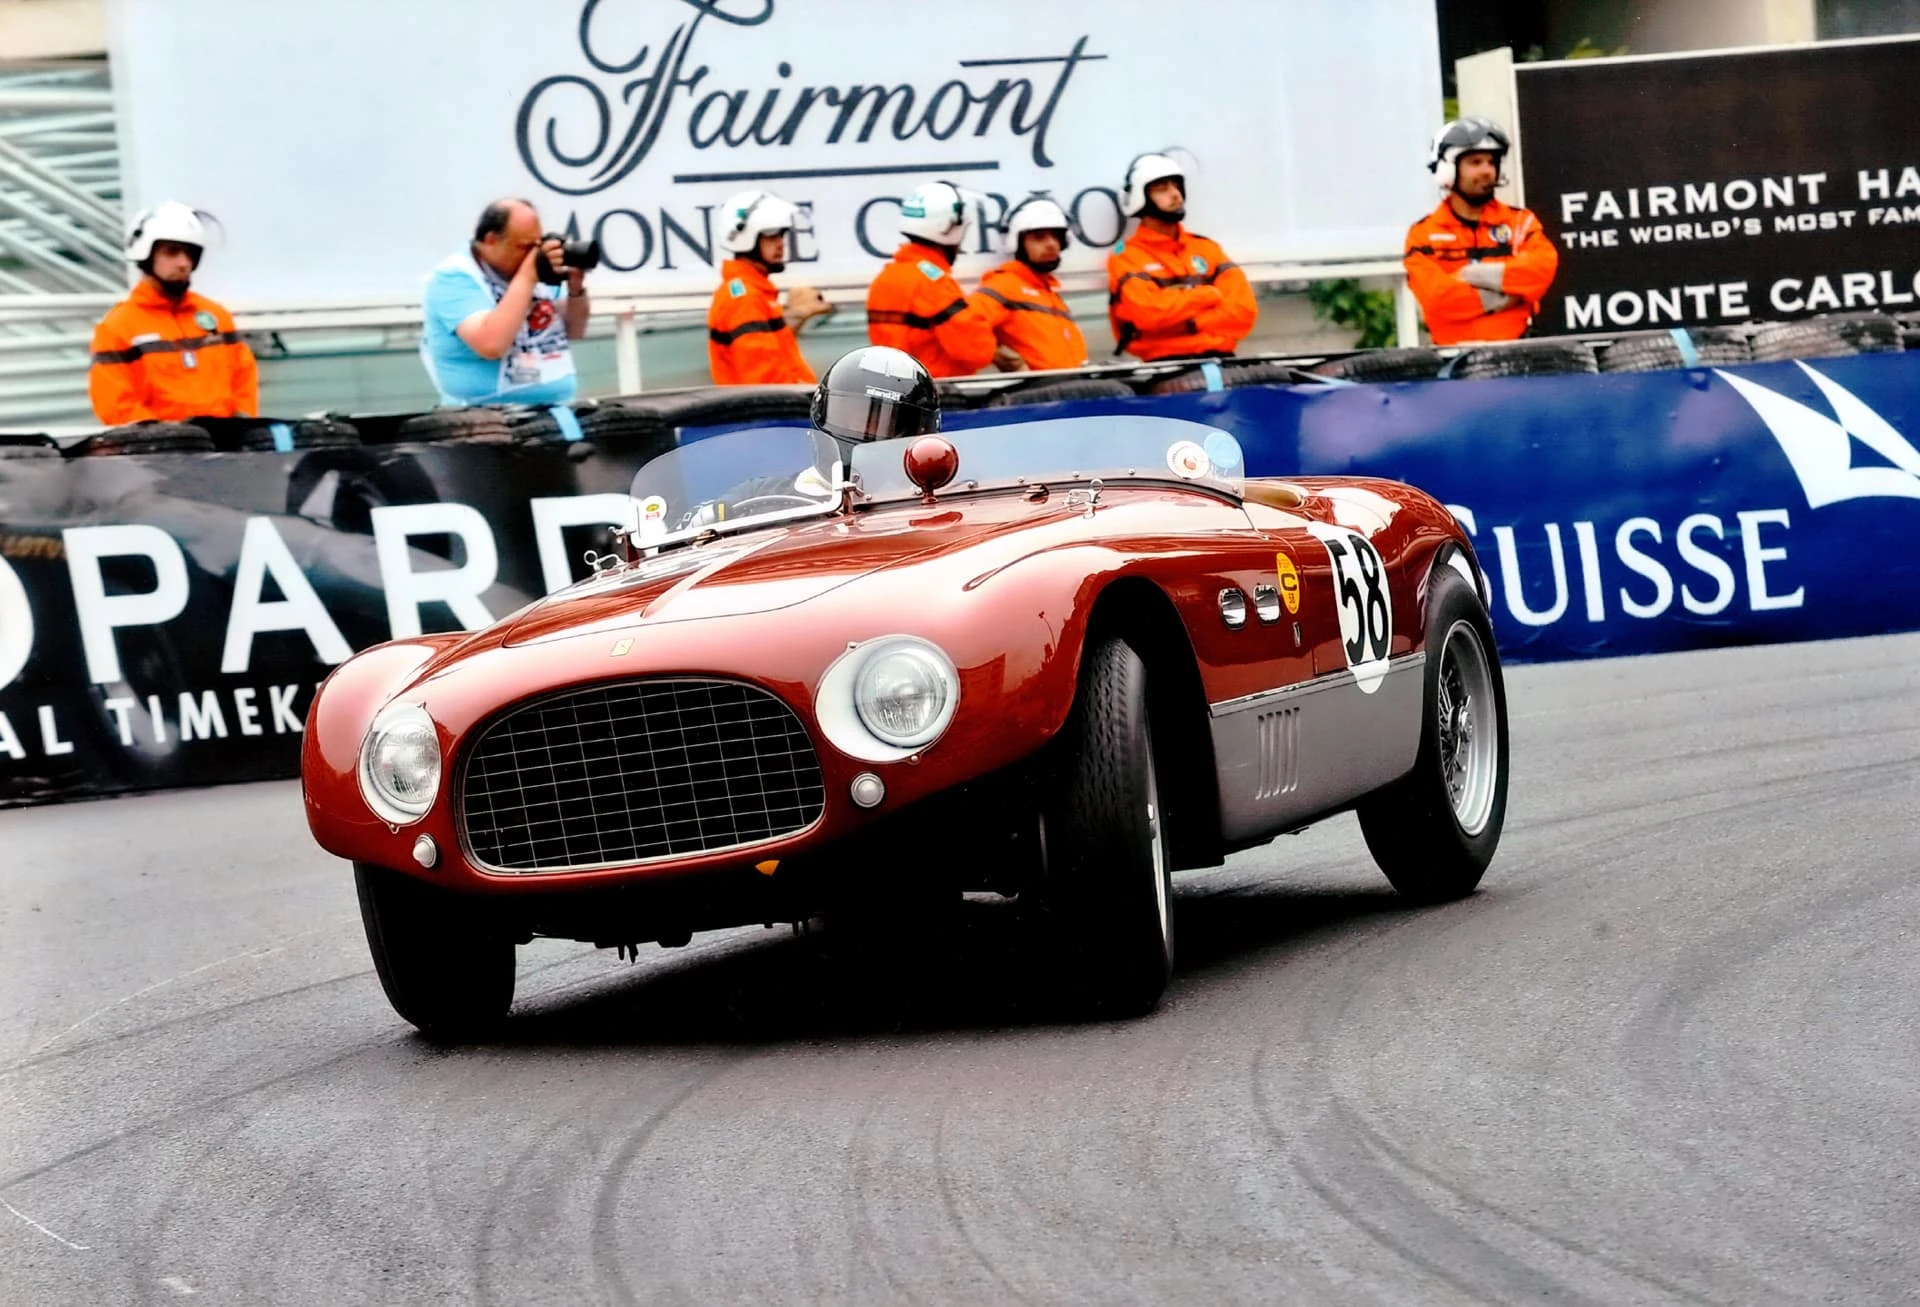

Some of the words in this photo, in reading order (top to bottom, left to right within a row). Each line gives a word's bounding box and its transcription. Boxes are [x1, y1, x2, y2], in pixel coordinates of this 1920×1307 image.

[515, 0, 1108, 196] Fairmont
[1560, 172, 1827, 223] FAIRMONT
[562, 200, 819, 273] ONE
[1560, 229, 1620, 250] THE
[1629, 217, 1762, 245] WORLD'S
[1774, 209, 1856, 234] MOST
[1564, 281, 1751, 330] MONTE
[1769, 269, 1920, 313] CARL
[1280, 572, 1298, 592] C
[1323, 533, 1390, 666] 58
